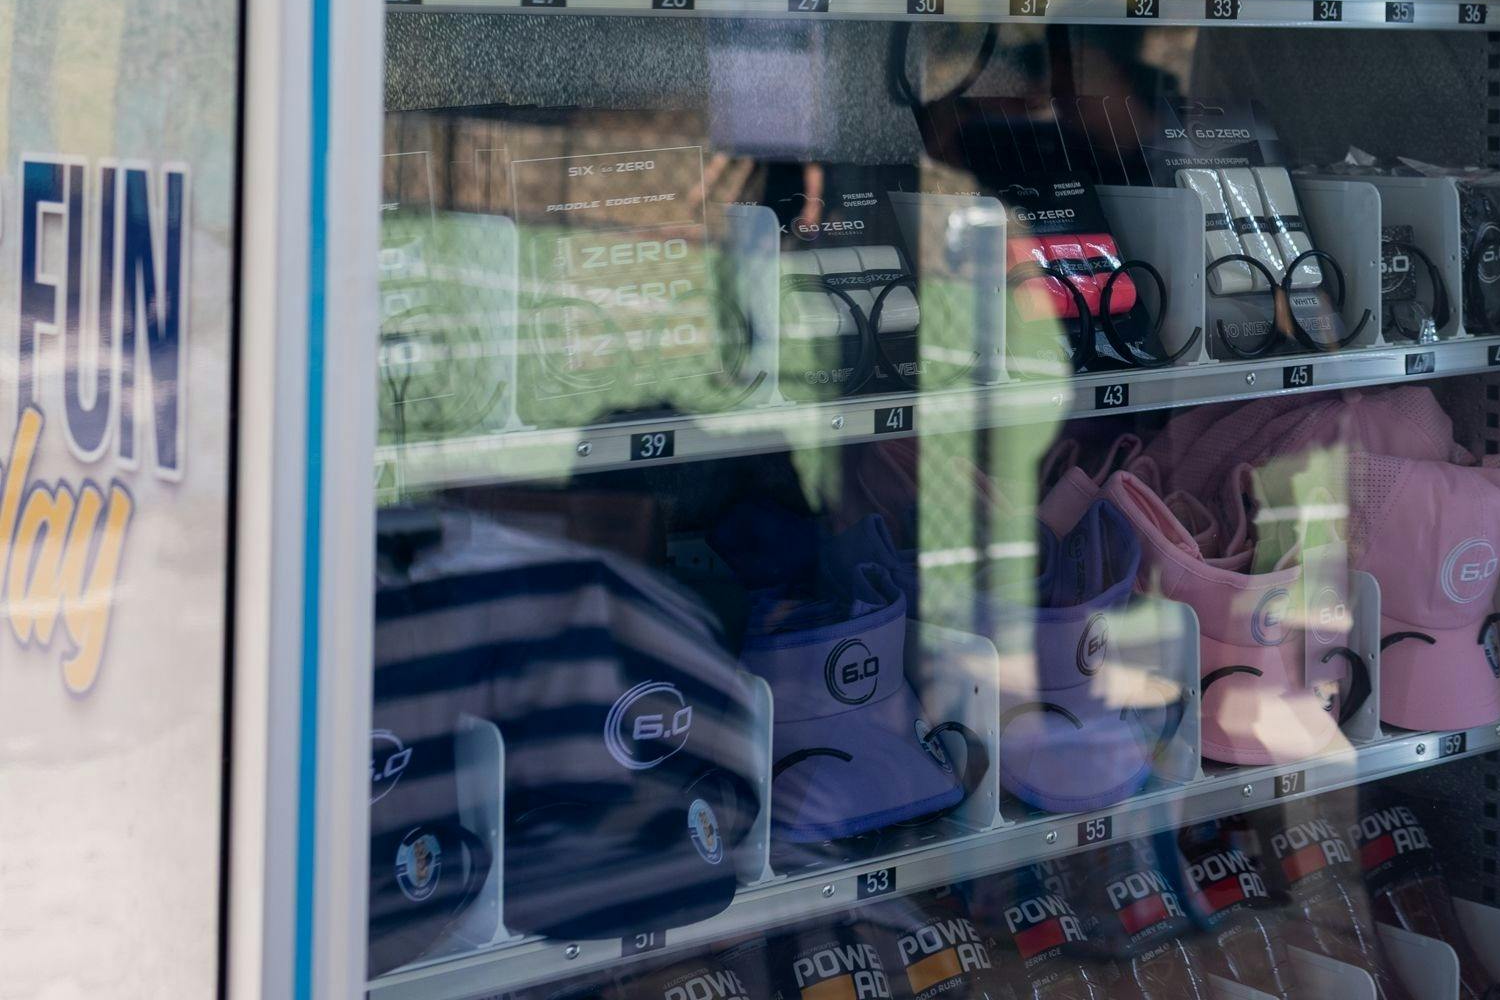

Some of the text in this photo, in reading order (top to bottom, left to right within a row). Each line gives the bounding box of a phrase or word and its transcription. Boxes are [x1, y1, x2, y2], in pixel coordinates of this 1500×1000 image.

[1320, 1, 1338, 20] 34
[1391, 2, 1409, 21] 35
[1464, 5, 1481, 23] 36
[1165, 129, 1188, 138] SIX
[1215, 129, 1251, 139] ZERO
[568, 165, 595, 177] SIX
[616, 160, 655, 173] ZERO
[1053, 181, 1081, 190] PREMIUM
[1055, 188, 1085, 197] OVERGRIP
[546, 193, 676, 212] PADDLE EDGE TAPE
[842, 191, 874, 201] PREMIUM
[843, 199, 878, 208] OVERGRIP
[1017, 208, 1075, 222] 6.0 ZERO
[798, 224, 820, 233] 6.0
[823, 220, 865, 232] ZERO
[580, 238, 688, 269] ZERO
[1292, 296, 1319, 306] WHITE
[20, 158, 187, 476] FUN
[1289, 366, 1309, 385] 45
[1103, 385, 1123, 405] 43
[886, 408, 904, 429] 41
[640, 433, 666, 458] 39
[0, 404, 132, 692] lay
[1460, 558, 1499, 583] 6.0
[841, 655, 880, 685] 6.0
[632, 705, 693, 740] 6.0
[1445, 734, 1462, 754] 59
[1281, 773, 1299, 793] 57
[1085, 820, 1106, 840] 55
[866, 867, 889, 892] 53
[938, 978, 963, 994] RUSH
